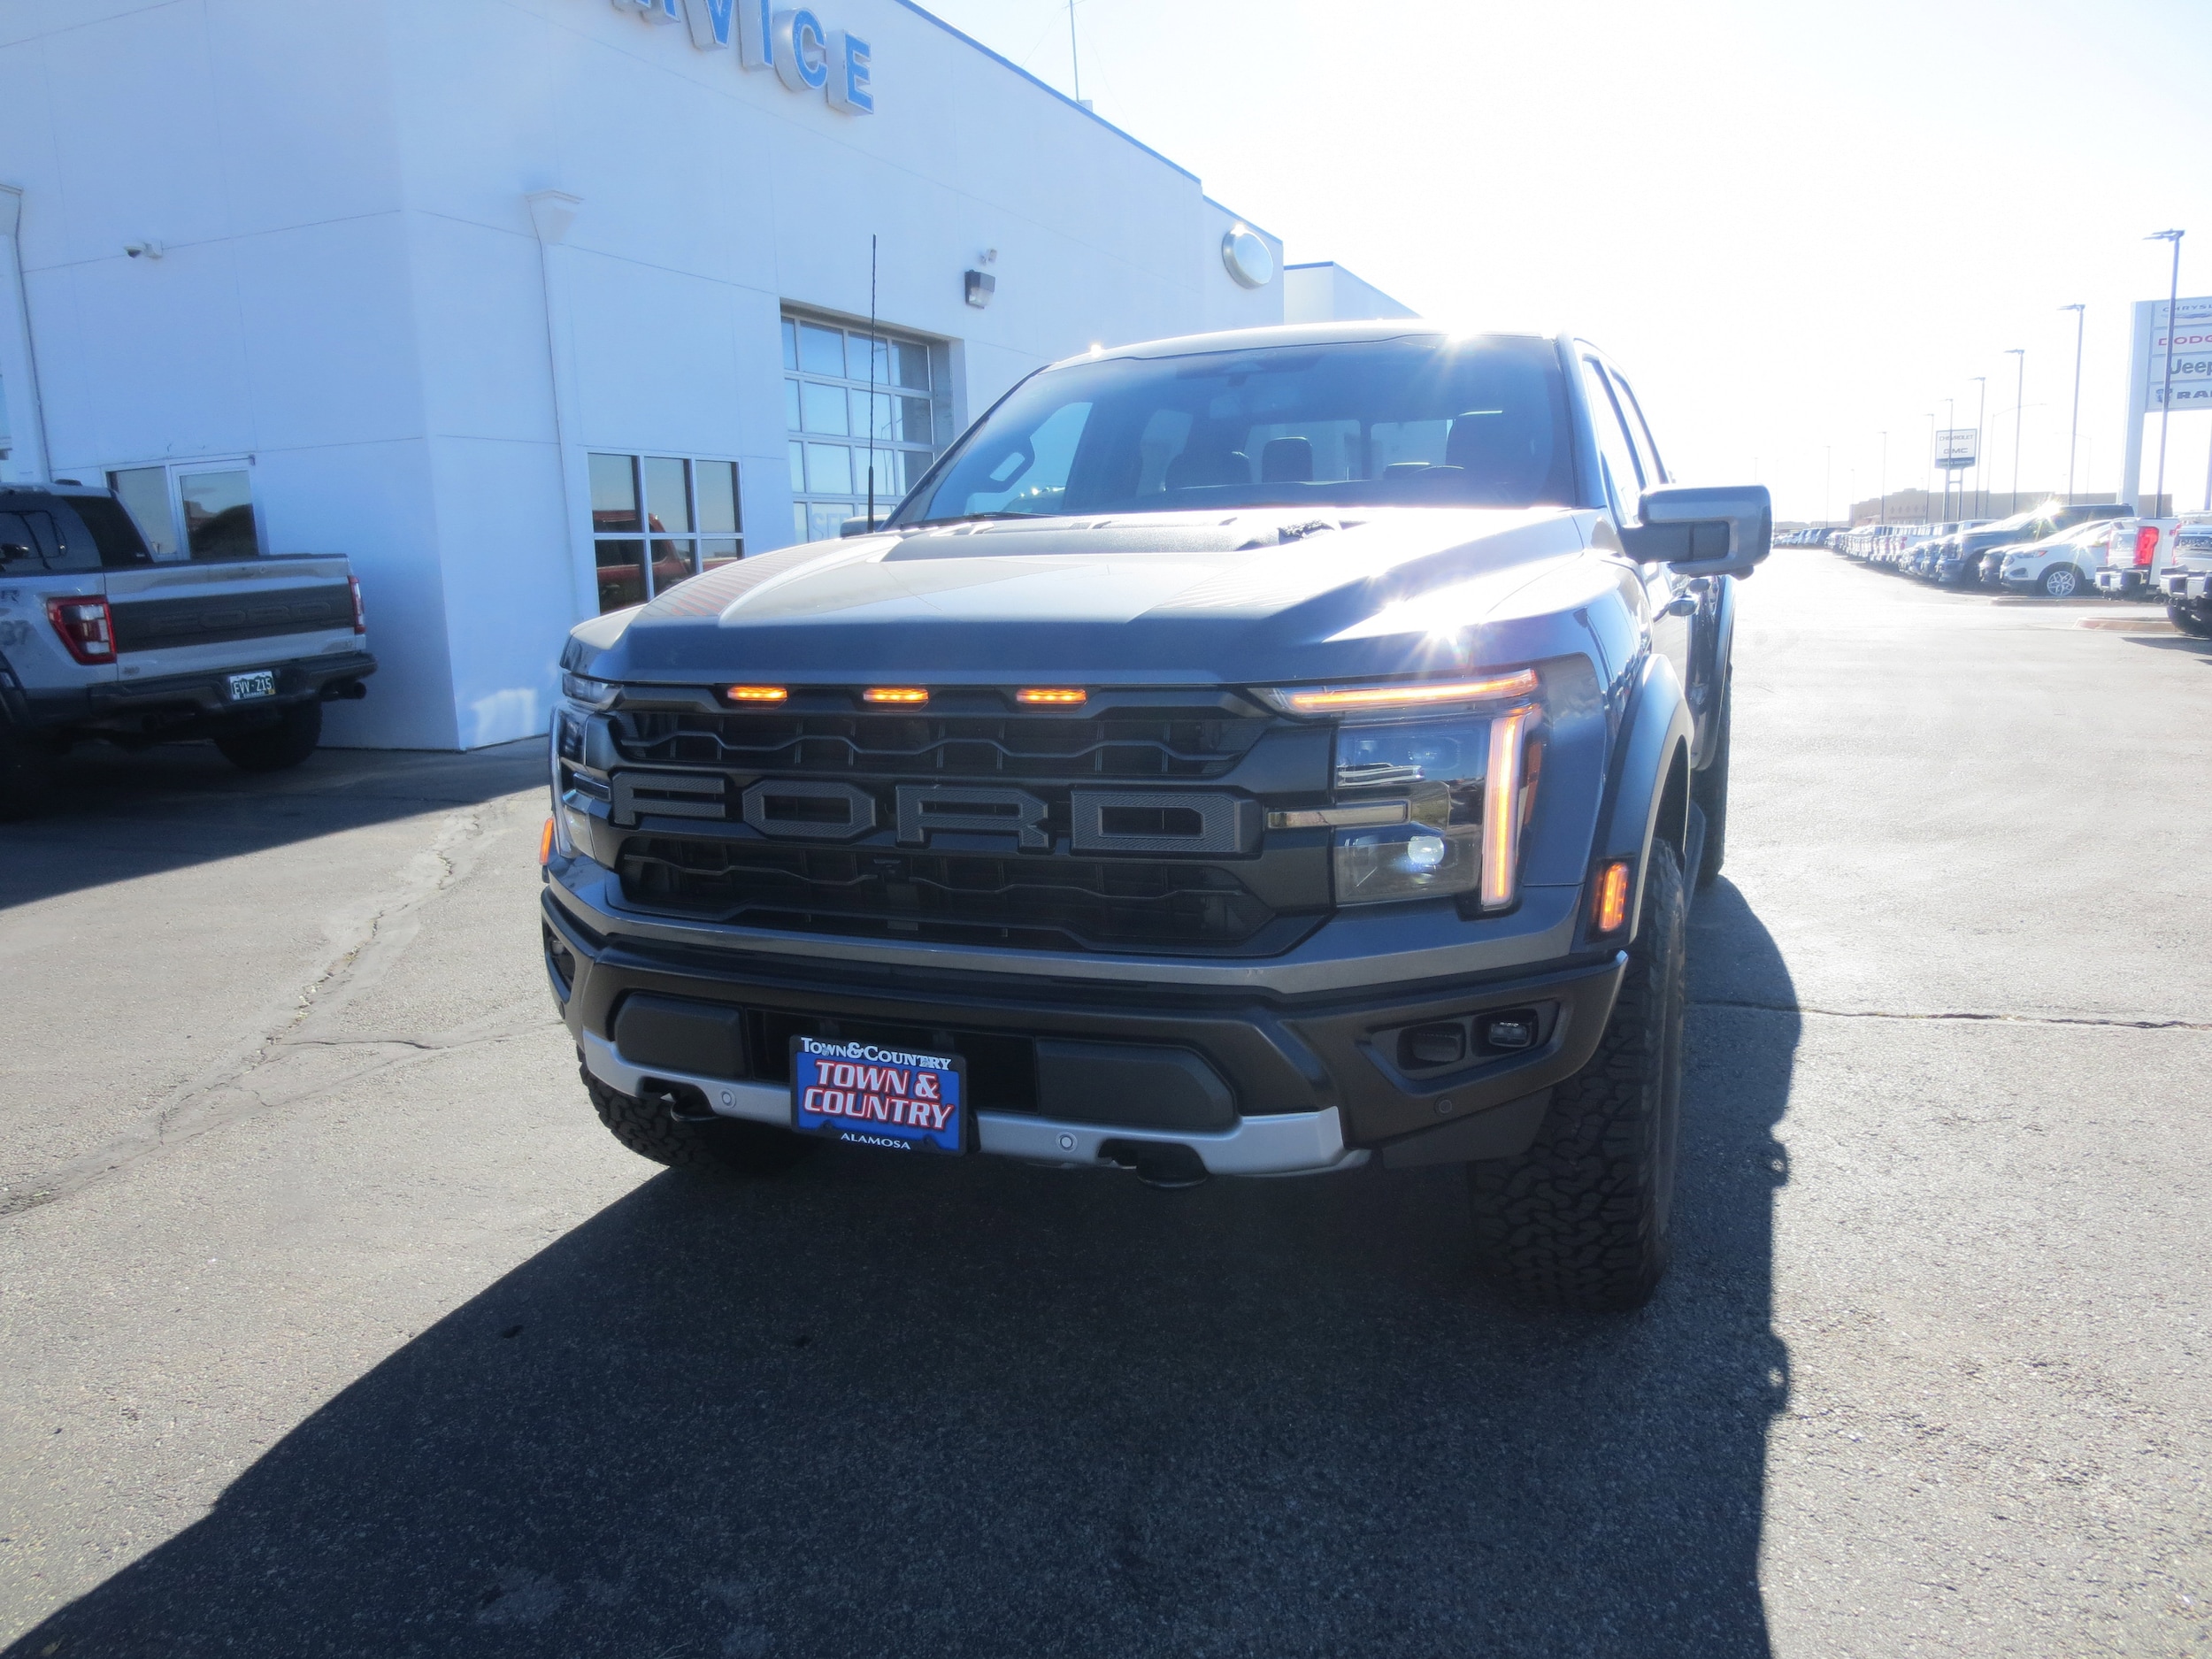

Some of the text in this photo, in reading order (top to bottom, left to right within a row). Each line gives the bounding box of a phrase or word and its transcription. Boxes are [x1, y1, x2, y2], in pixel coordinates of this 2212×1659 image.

[619, 0, 874, 115] VICE
[2177, 390, 2212, 400] RA
[612, 772, 1242, 855] FORD
[816, 1059, 940, 1100] TOWN &
[803, 1087, 954, 1131] COUNTRY
[841, 1133, 911, 1150] ALAMOSA
